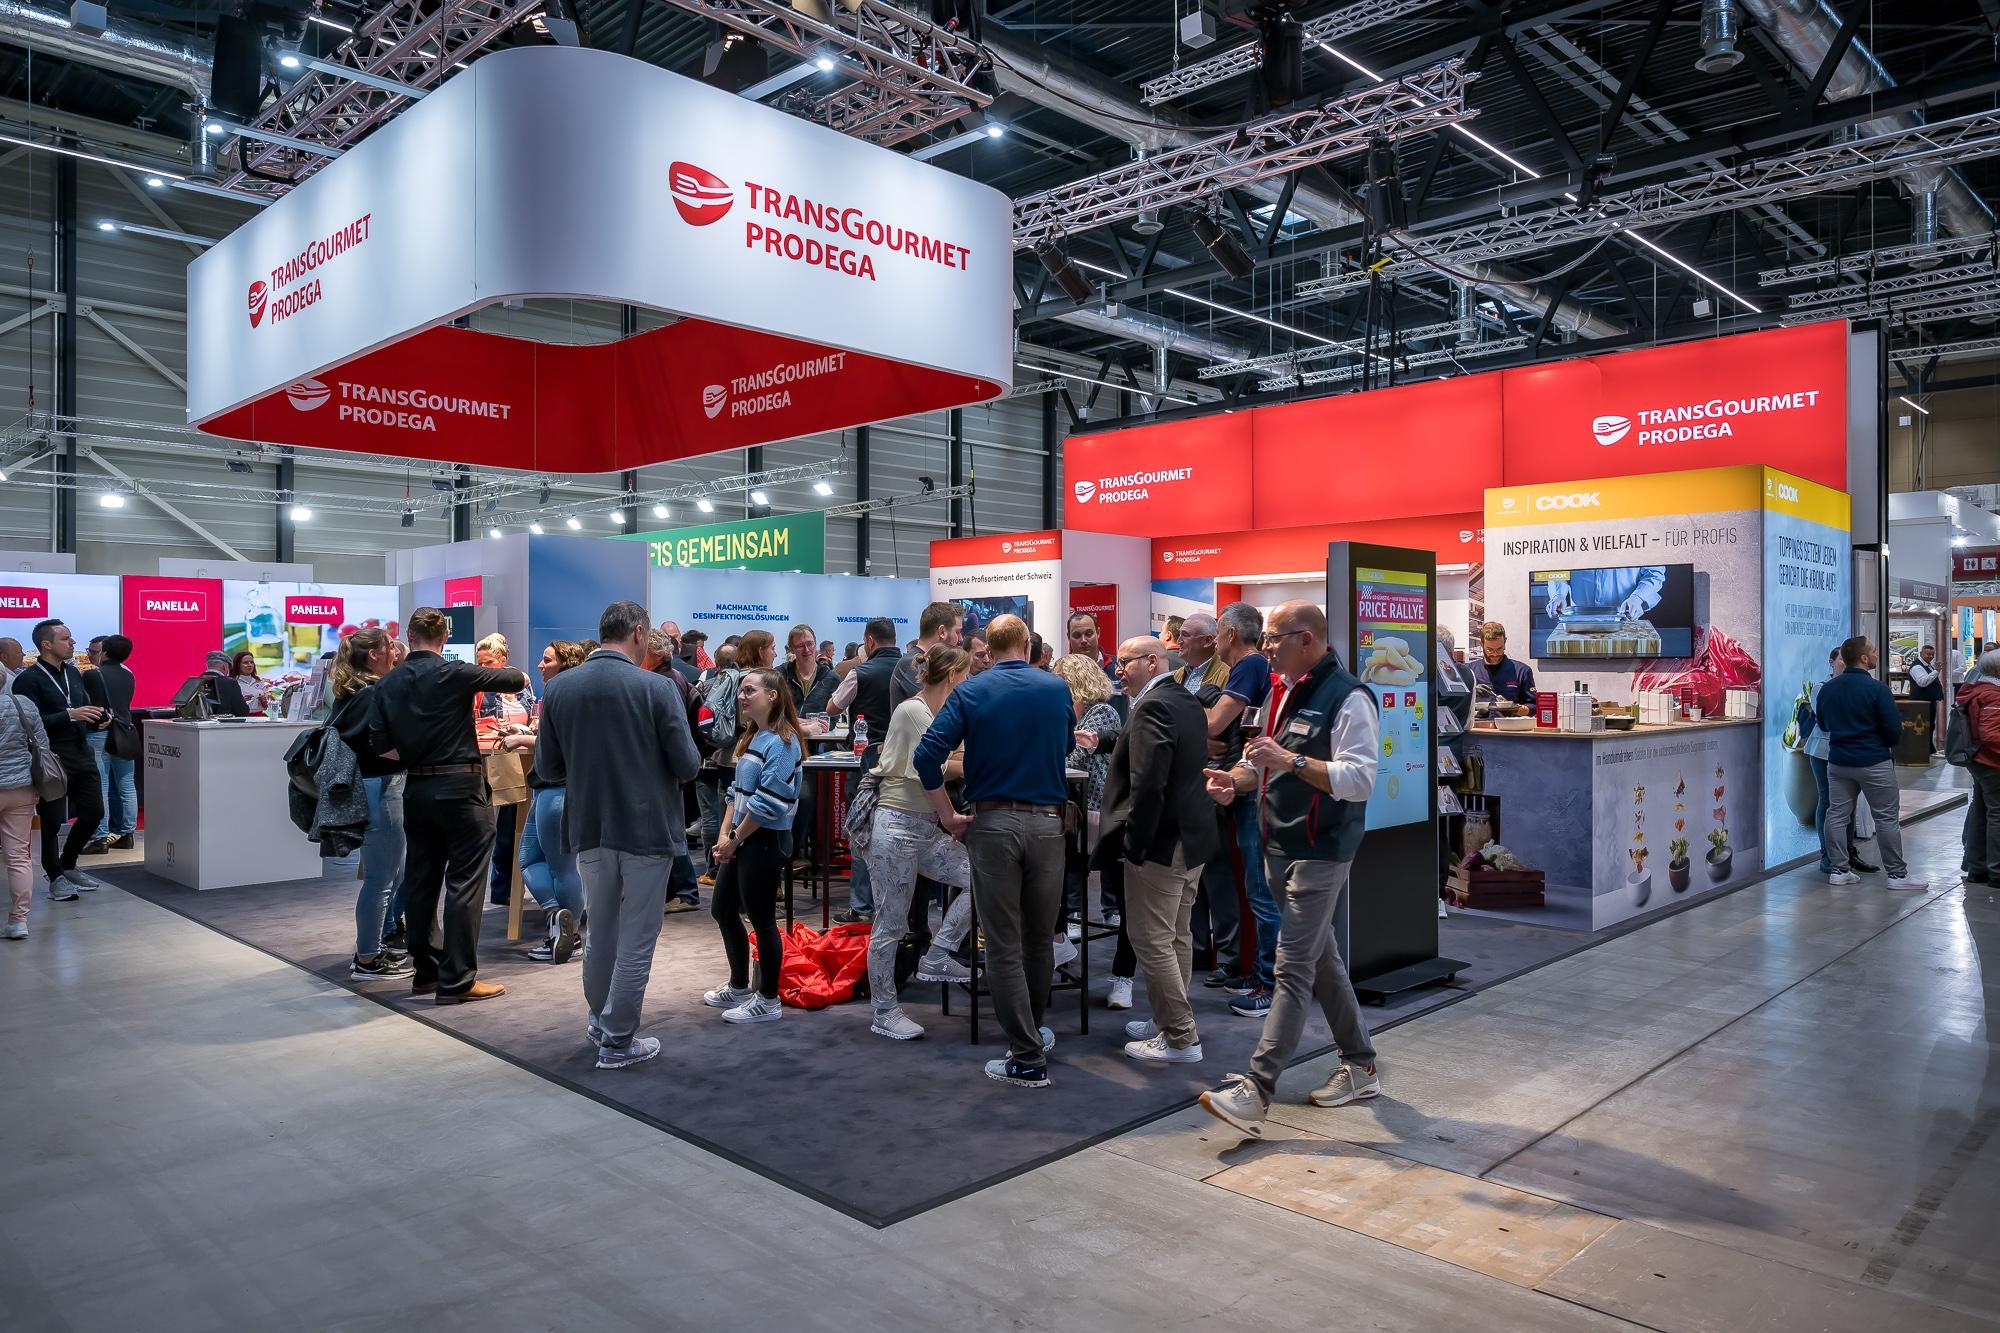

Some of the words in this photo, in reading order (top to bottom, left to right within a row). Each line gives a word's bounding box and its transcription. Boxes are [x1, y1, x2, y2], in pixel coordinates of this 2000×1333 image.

[744, 181, 971, 271] TRANSGOURMET
[271, 213, 371, 292] TRANSGOURMET
[746, 222, 876, 281] PRODEGA
[271, 278, 322, 325] PRODEGA
[730, 352, 846, 395] TRANSGOURMET
[338, 381, 511, 420] TRANSGOURMET
[731, 390, 792, 418] PRODEGA
[1638, 390, 1820, 426] TRANSGOURMET
[339, 405, 437, 432] PRODEGA
[1638, 422, 1733, 446] PRODEGA
[1098, 467, 1193, 489] TRANSGOURMET
[1099, 488, 1149, 504] PRODEGA
[1535, 491, 1602, 511] COOK
[1778, 483, 1799, 503] COOK
[676, 527, 789, 564] GEMEINSAM
[1013, 538, 1056, 547] TRANSGOURMET
[1503, 537, 1575, 555] INSPIRATION
[1580, 537, 1589, 552] &
[1593, 532, 1648, 551] VIELFALT
[1664, 529, 1689, 547] FÜR
[1693, 527, 1738, 545] PROFIS
[1175, 548, 1222, 557] TRANSGOURMET
[937, 577, 948, 585] Das
[971, 573, 1014, 583] Profisortiment
[1015, 573, 1026, 581] der
[1027, 571, 1052, 580] Schweiz
[146, 599, 199, 613] PANELLA
[291, 604, 338, 616] PANELLA
[692, 611, 790, 622] DESINFEKTIONSLÖSUNGEN
[716, 603, 768, 612] NACHHALTIGE
[1359, 600, 1387, 618] PRICE
[1389, 602, 1424, 620] RALLYE
[837, 616, 909, 624] WASSERDTION
